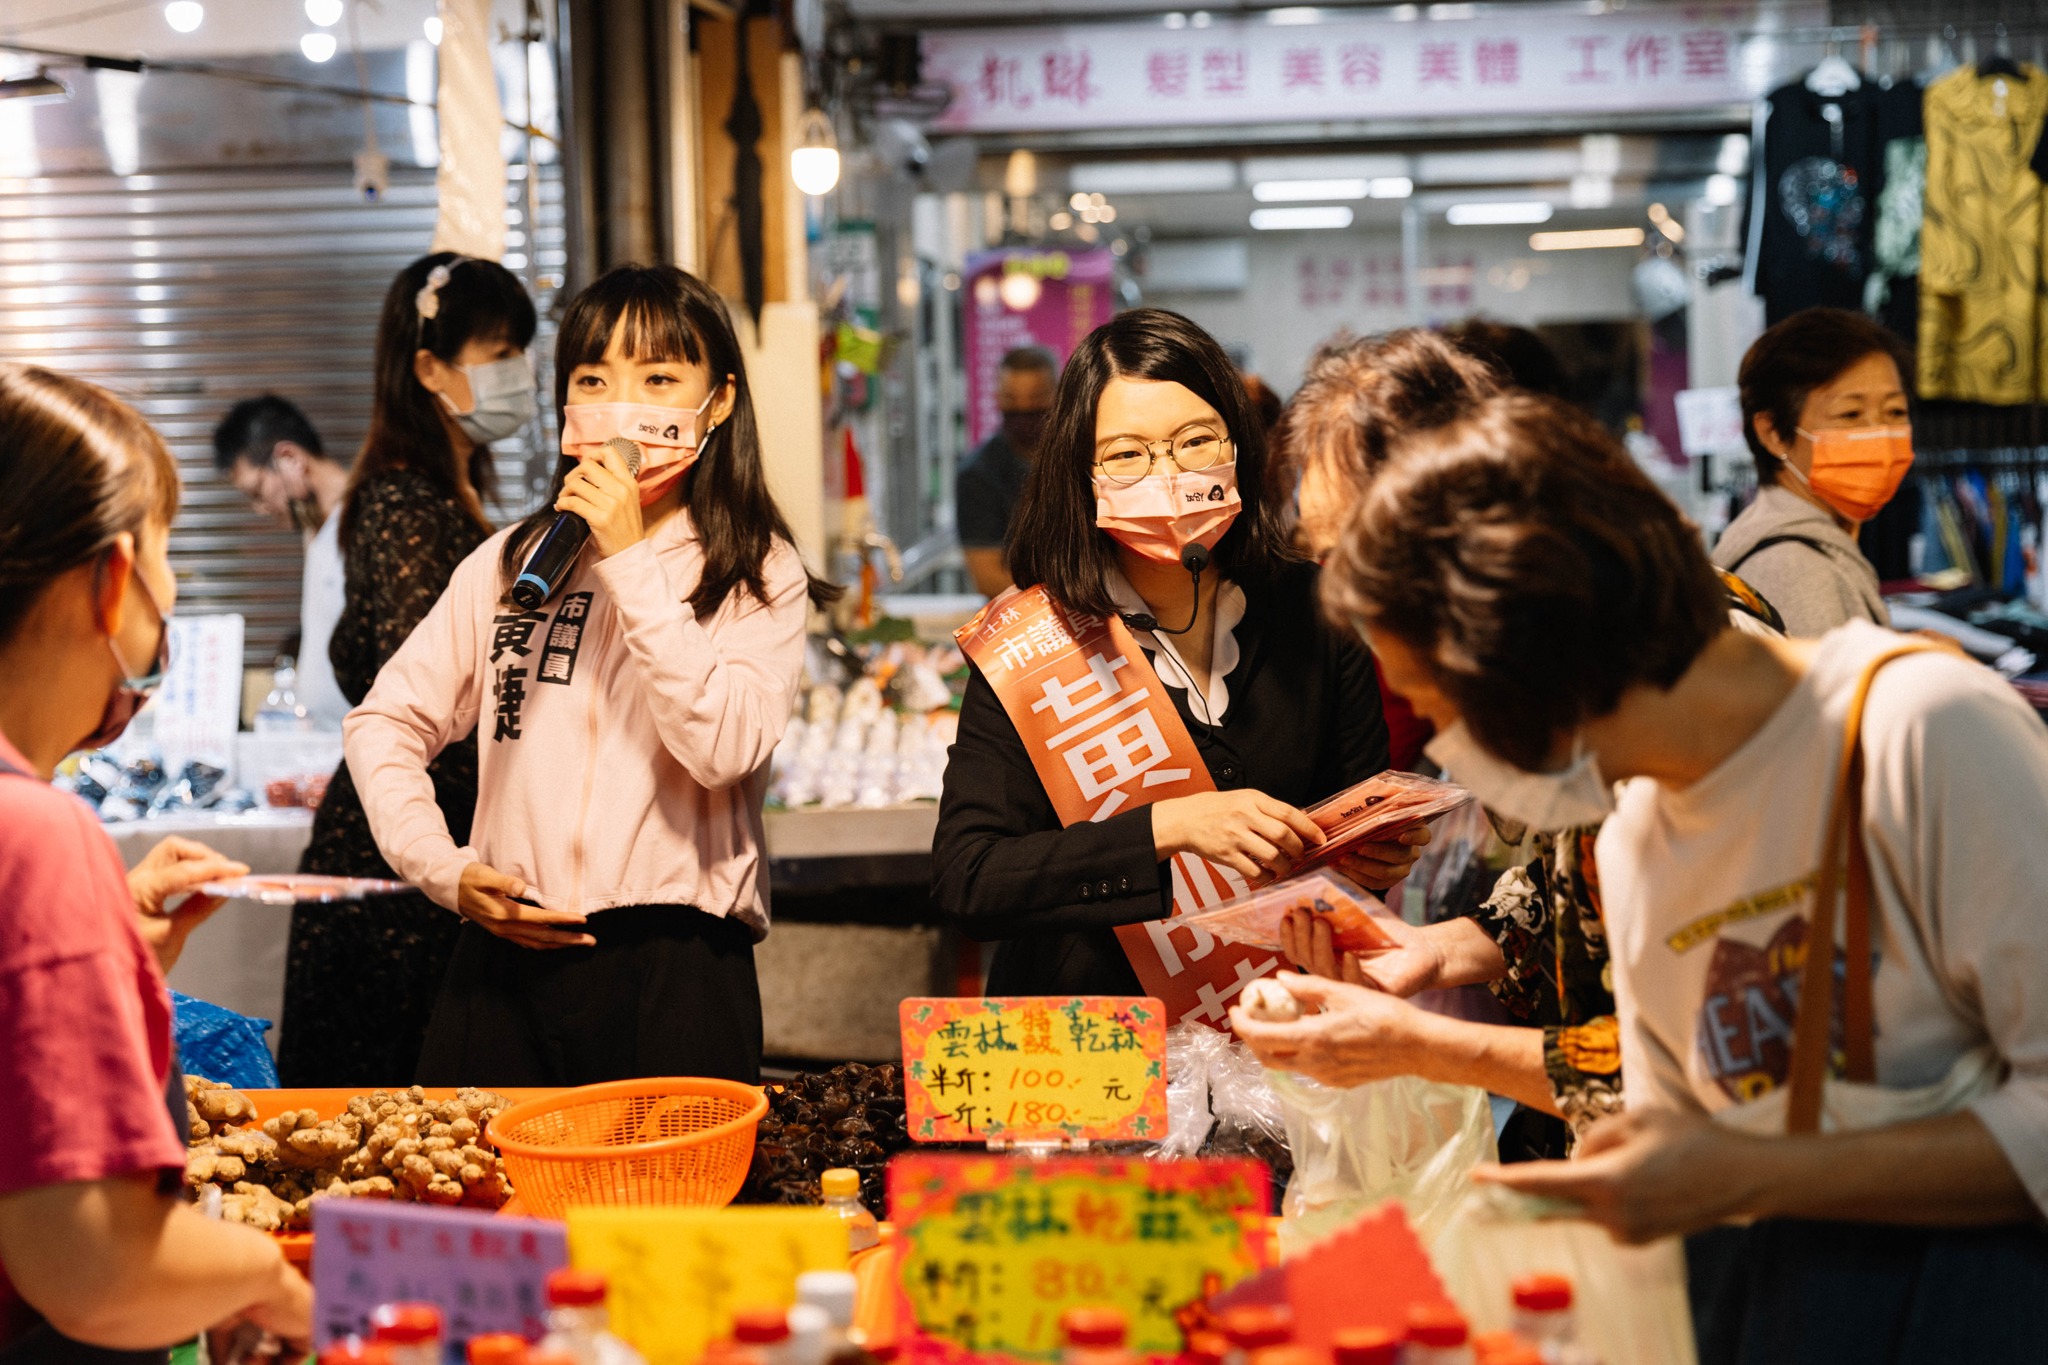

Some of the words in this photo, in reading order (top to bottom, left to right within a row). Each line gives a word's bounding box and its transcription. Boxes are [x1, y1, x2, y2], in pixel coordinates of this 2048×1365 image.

[1282, 44, 1382, 89] 美容
[1417, 38, 1521, 86] 美體
[1563, 29, 1728, 86] 工作室
[541, 595, 590, 681] 市議員
[983, 606, 1022, 639] 士林
[937, 1019, 1019, 1059] 雲林
[1102, 1078, 1131, 1101] 元
